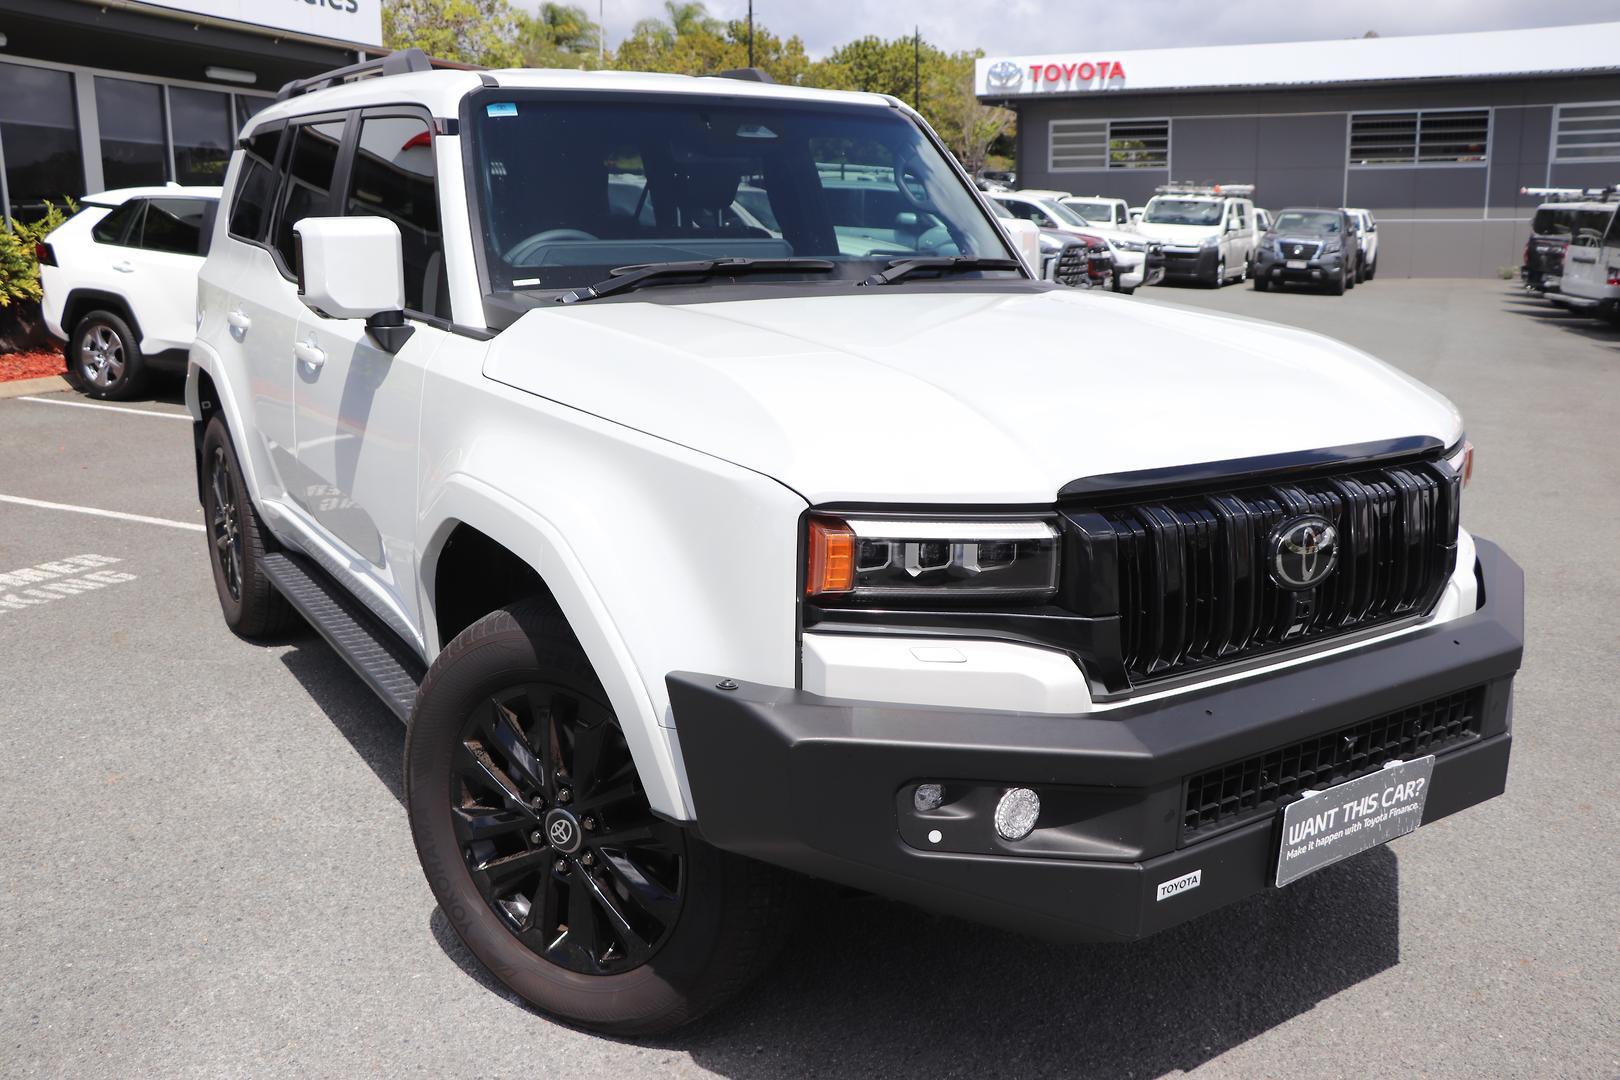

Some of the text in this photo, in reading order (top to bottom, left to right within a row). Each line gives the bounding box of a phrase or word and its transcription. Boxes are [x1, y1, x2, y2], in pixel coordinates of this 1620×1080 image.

[1029, 61, 1126, 83] TOYOTA
[1289, 777, 1425, 845] WANT THIS CAR?
[1286, 846, 1307, 861] Make
[1308, 842, 1315, 850] it
[1316, 830, 1344, 848] happen
[1344, 822, 1362, 836] with
[1364, 812, 1389, 828] Toyota
[1161, 875, 1198, 896] TOYOTA
